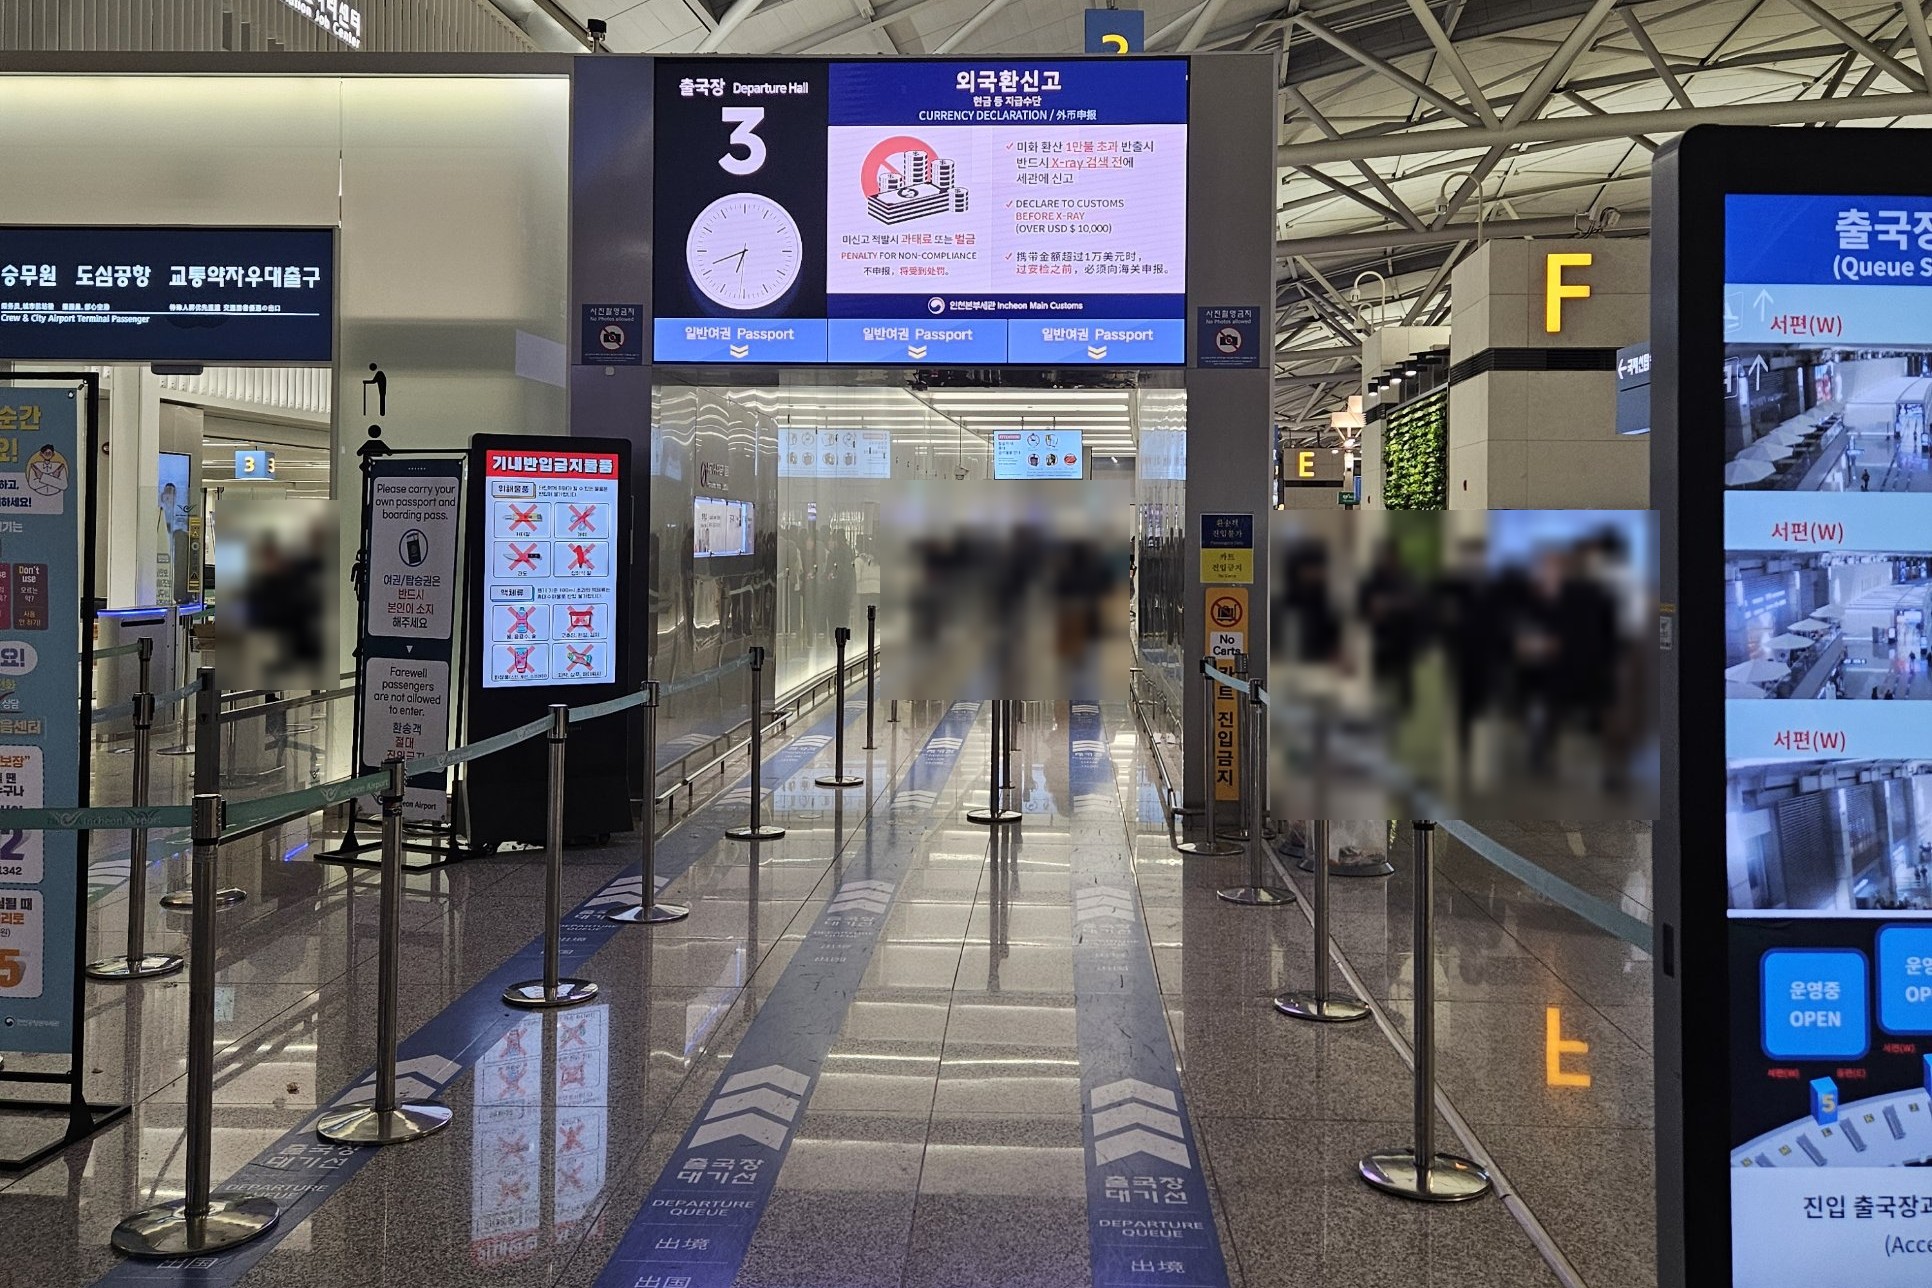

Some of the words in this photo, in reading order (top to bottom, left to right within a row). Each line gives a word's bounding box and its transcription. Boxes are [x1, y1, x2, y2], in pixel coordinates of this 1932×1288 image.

[333, 21, 360, 48] Center
[679, 78, 725, 96] 출국장
[733, 82, 787, 96] Departure
[789, 82, 809, 94] Hall
[955, 70, 1062, 93] 외국환신고
[973, 96, 992, 107] 현금
[993, 96, 1003, 107] 등
[1005, 96, 1042, 107] 지급수단
[918, 110, 975, 121] CURRENCY
[976, 110, 1047, 121] DECLARATION
[718, 106, 767, 175] 3
[1017, 141, 1038, 153] 미화
[1041, 141, 1062, 153] 환산
[1066, 141, 1094, 153] 1만불
[1097, 141, 1118, 153] 초과
[1121, 140, 1155, 153] 반출시
[1016, 157, 1049, 169] 반드시
[1052, 157, 1084, 171] X-ray
[1086, 157, 1109, 169] 검색
[1111, 157, 1134, 169] 전에
[1016, 173, 1049, 184] 세관에
[1051, 173, 1074, 184] 신고
[1016, 199, 1060, 209] DECLARE
[1061, 199, 1075, 209] TO
[1076, 199, 1125, 209] CUSTOMS
[1015, 212, 1054, 221] BEFORE
[1056, 212, 1085, 221] X-RAY
[1015, 223, 1045, 234] (OVER
[1047, 223, 1067, 234] USD
[1069, 223, 1076, 234] $
[1077, 223, 1112, 234] 10,000)
[842, 234, 870, 245] 미신고
[871, 234, 899, 245] 적발시
[901, 234, 932, 245] 과태료
[934, 234, 953, 245] 또는
[955, 234, 976, 245] 벌금
[841, 252, 878, 260] PENALTY
[879, 252, 897, 260] FOR
[898, 252, 977, 260] NON-COMPLIANCE
[1833, 254, 1914, 280] (Queue
[1, 264, 57, 287] 승무원
[75, 264, 151, 288] 도심공항
[169, 266, 320, 288] 교통약자우대출구
[1546, 253, 1592, 333] F
[950, 300, 996, 311] 인천본부세관
[997, 301, 1028, 310] Incheon
[1029, 301, 1049, 310] Main
[1050, 301, 1083, 310] Customs
[1, 314, 20, 322] Crew
[22, 314, 29, 322] &
[31, 314, 46, 324] City
[48, 314, 75, 324] Airport
[77, 315, 110, 323] Terminal
[111, 315, 150, 325] Passenger
[1770, 315, 1842, 337] 서편(W)
[685, 327, 731, 340] 일반여권
[737, 328, 795, 341] Passport
[863, 327, 909, 341] 일반여권
[915, 328, 973, 342] Passport
[1042, 327, 1089, 341] 일반여권
[1095, 328, 1153, 342] Passport
[243, 457, 255, 473] 3
[268, 458, 276, 473] 3
[1299, 451, 1315, 477] E
[377, 484, 407, 494] Please
[408, 485, 434, 496] carry
[435, 485, 456, 496] your
[0, 497, 32, 508] 하세요!
[376, 498, 395, 506] own
[396, 498, 437, 509] passport
[438, 497, 456, 507] and
[382, 510, 422, 522] boarding
[424, 511, 448, 522] pass.
[0, 521, 23, 534] 기는
[1771, 522, 1844, 544] 서편(W)
[19, 565, 40, 575] Don't
[22, 575, 36, 583] use
[384, 574, 441, 587] 여권/탑승권은
[399, 589, 424, 600] 반드시
[388, 602, 414, 614] 본인이
[416, 603, 434, 615] 소지
[392, 617, 428, 629] 해주세요
[1220, 635, 1235, 645] No
[1213, 646, 1241, 655] Carts
[390, 667, 428, 678] Farewell
[382, 681, 434, 692] passengers
[374, 693, 389, 701] are
[391, 694, 405, 702] not
[407, 694, 441, 705] allowed
[389, 705, 398, 715] to
[400, 706, 425, 717] enter.
[393, 722, 422, 735] 환송객
[395, 737, 414, 749] 절대
[1774, 731, 1846, 752] 서편(W)
[1217, 712, 1234, 786] 진입금지
[415, 801, 437, 810] Airport
[1789, 982, 1841, 1000] 운영중
[1789, 1011, 1841, 1027] OPEN
[1821, 1095, 1836, 1113] 5
[683, 1157, 764, 1171] 출국장
[677, 1171, 758, 1185] 대기선
[1105, 1176, 1184, 1190] 출국장
[226, 1184, 329, 1192] DEPARTURE
[1105, 1190, 1188, 1204] 대기선
[652, 1199, 754, 1209] DEPARTURE
[1803, 1195, 1846, 1219] 진입
[670, 1208, 728, 1217] QUEUE
[1099, 1219, 1204, 1230] DEPARTURE
[1122, 1229, 1183, 1238] QUEUE
